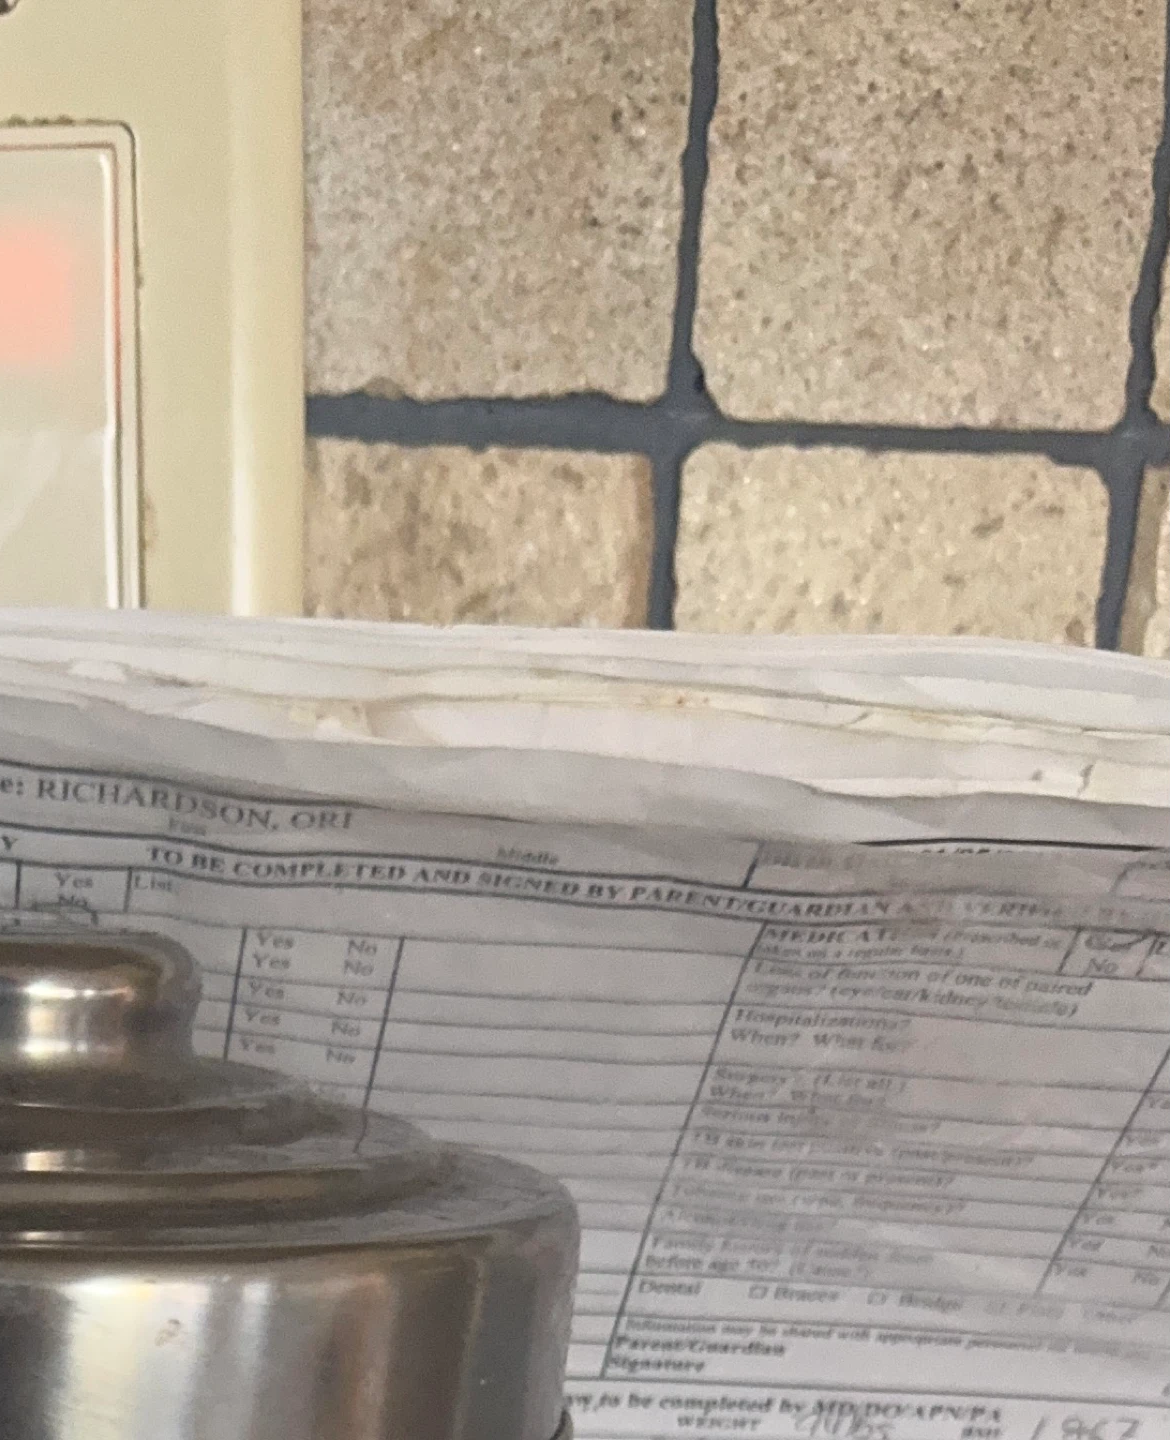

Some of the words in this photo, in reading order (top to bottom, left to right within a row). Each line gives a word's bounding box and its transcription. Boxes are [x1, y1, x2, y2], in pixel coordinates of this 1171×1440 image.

[38, 776, 278, 830] RICHARDSON,
[290, 810, 353, 830] ORI
[55, 871, 94, 889] Yes
[147, 847, 184, 866] TO
[191, 855, 225, 874] BE
[232, 860, 405, 881] COMPLETED
[413, 865, 471, 885] AND
[478, 871, 581, 897] SIGNED
[585, 883, 627, 901] BY
[134, 874, 174, 893] List
[256, 930, 295, 950] Yes
[347, 939, 378, 955] No
[252, 952, 291, 970] Yes
[343, 959, 376, 977] No
[1086, 957, 1120, 976] No
[248, 981, 285, 1000] Yes
[336, 991, 369, 1006] No
[244, 1008, 281, 1025] Yes
[331, 1020, 361, 1038] No
[240, 1037, 276, 1054] Yes
